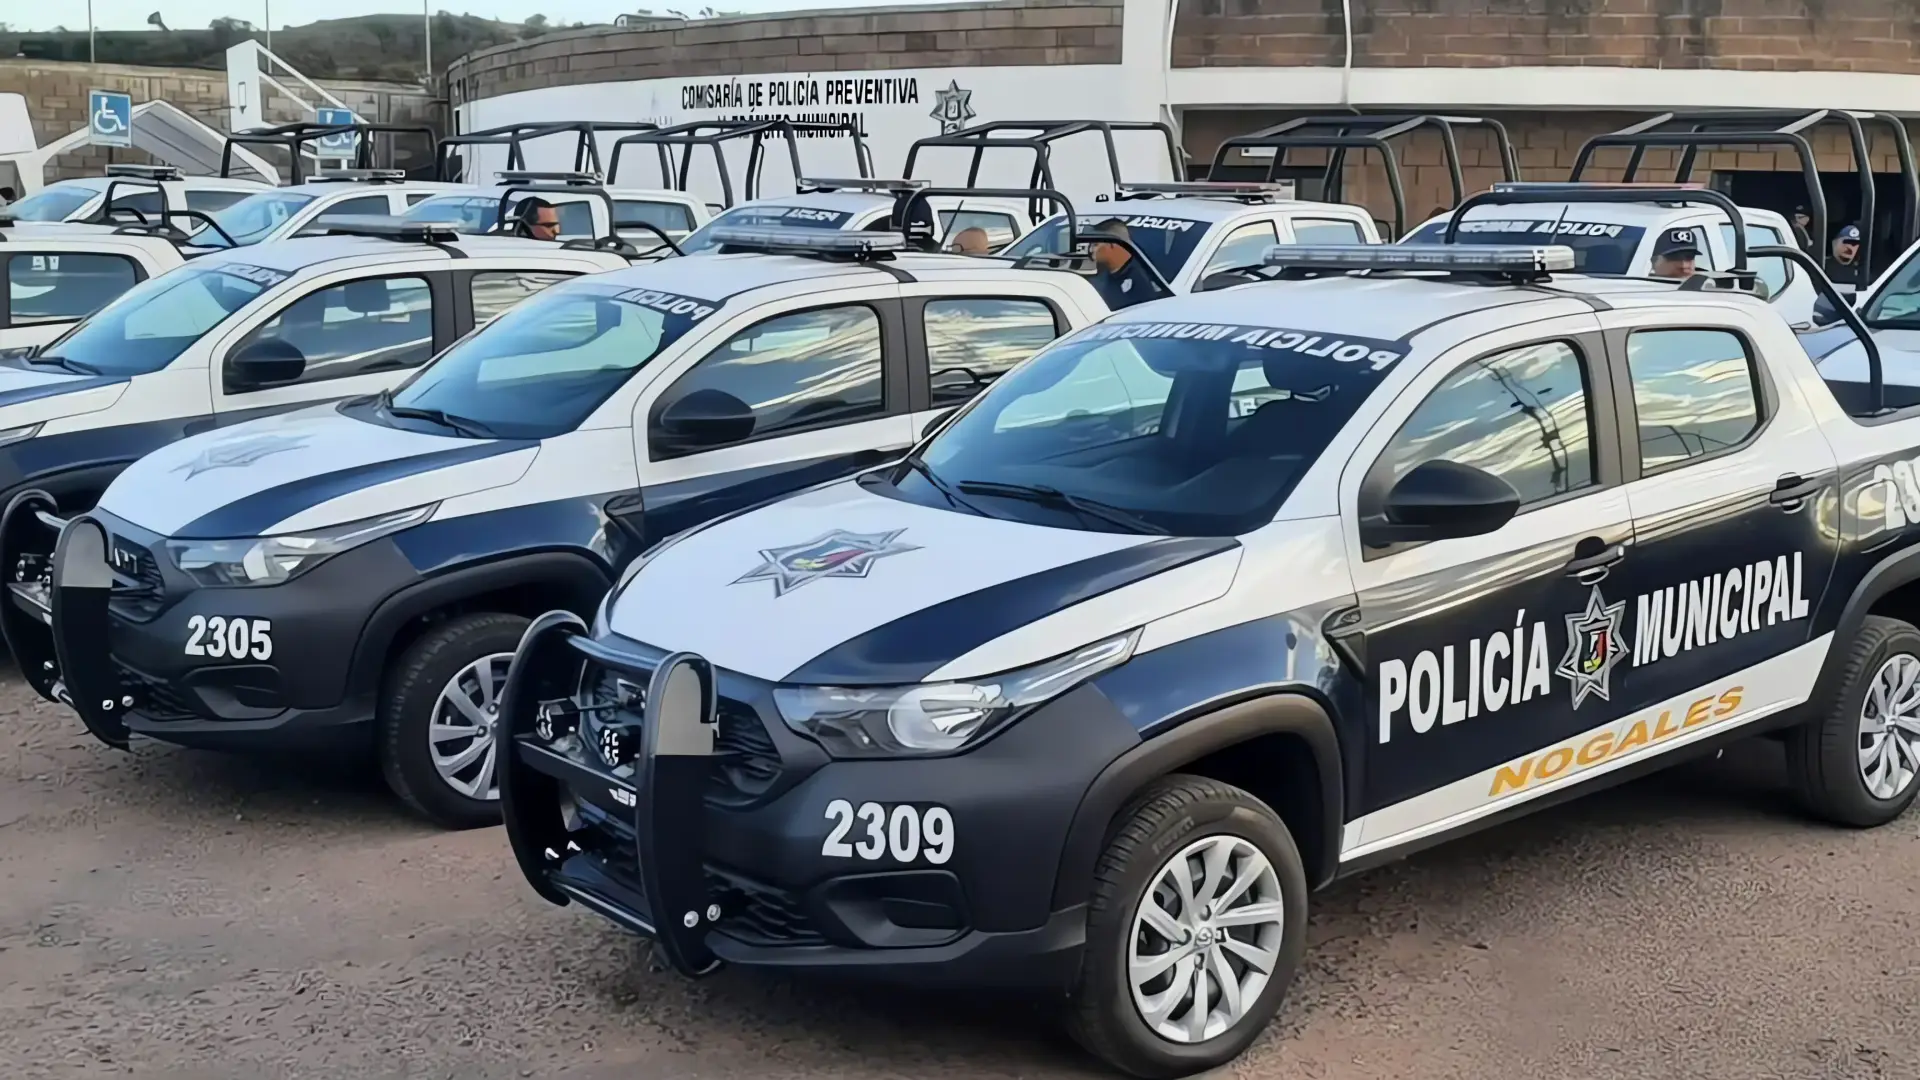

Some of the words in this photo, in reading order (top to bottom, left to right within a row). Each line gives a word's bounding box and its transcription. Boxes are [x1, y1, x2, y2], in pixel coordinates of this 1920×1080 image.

[749, 82, 763, 107] DE
[769, 73, 820, 107] POLICÍA
[826, 78, 919, 105] PREVENTIVA
[184, 614, 273, 661] 2305
[1379, 608, 1550, 744] POLICÍA
[1632, 551, 1809, 667] MUNICIPAL
[1488, 685, 1745, 797] NOGALES
[821, 799, 955, 865] 2309
